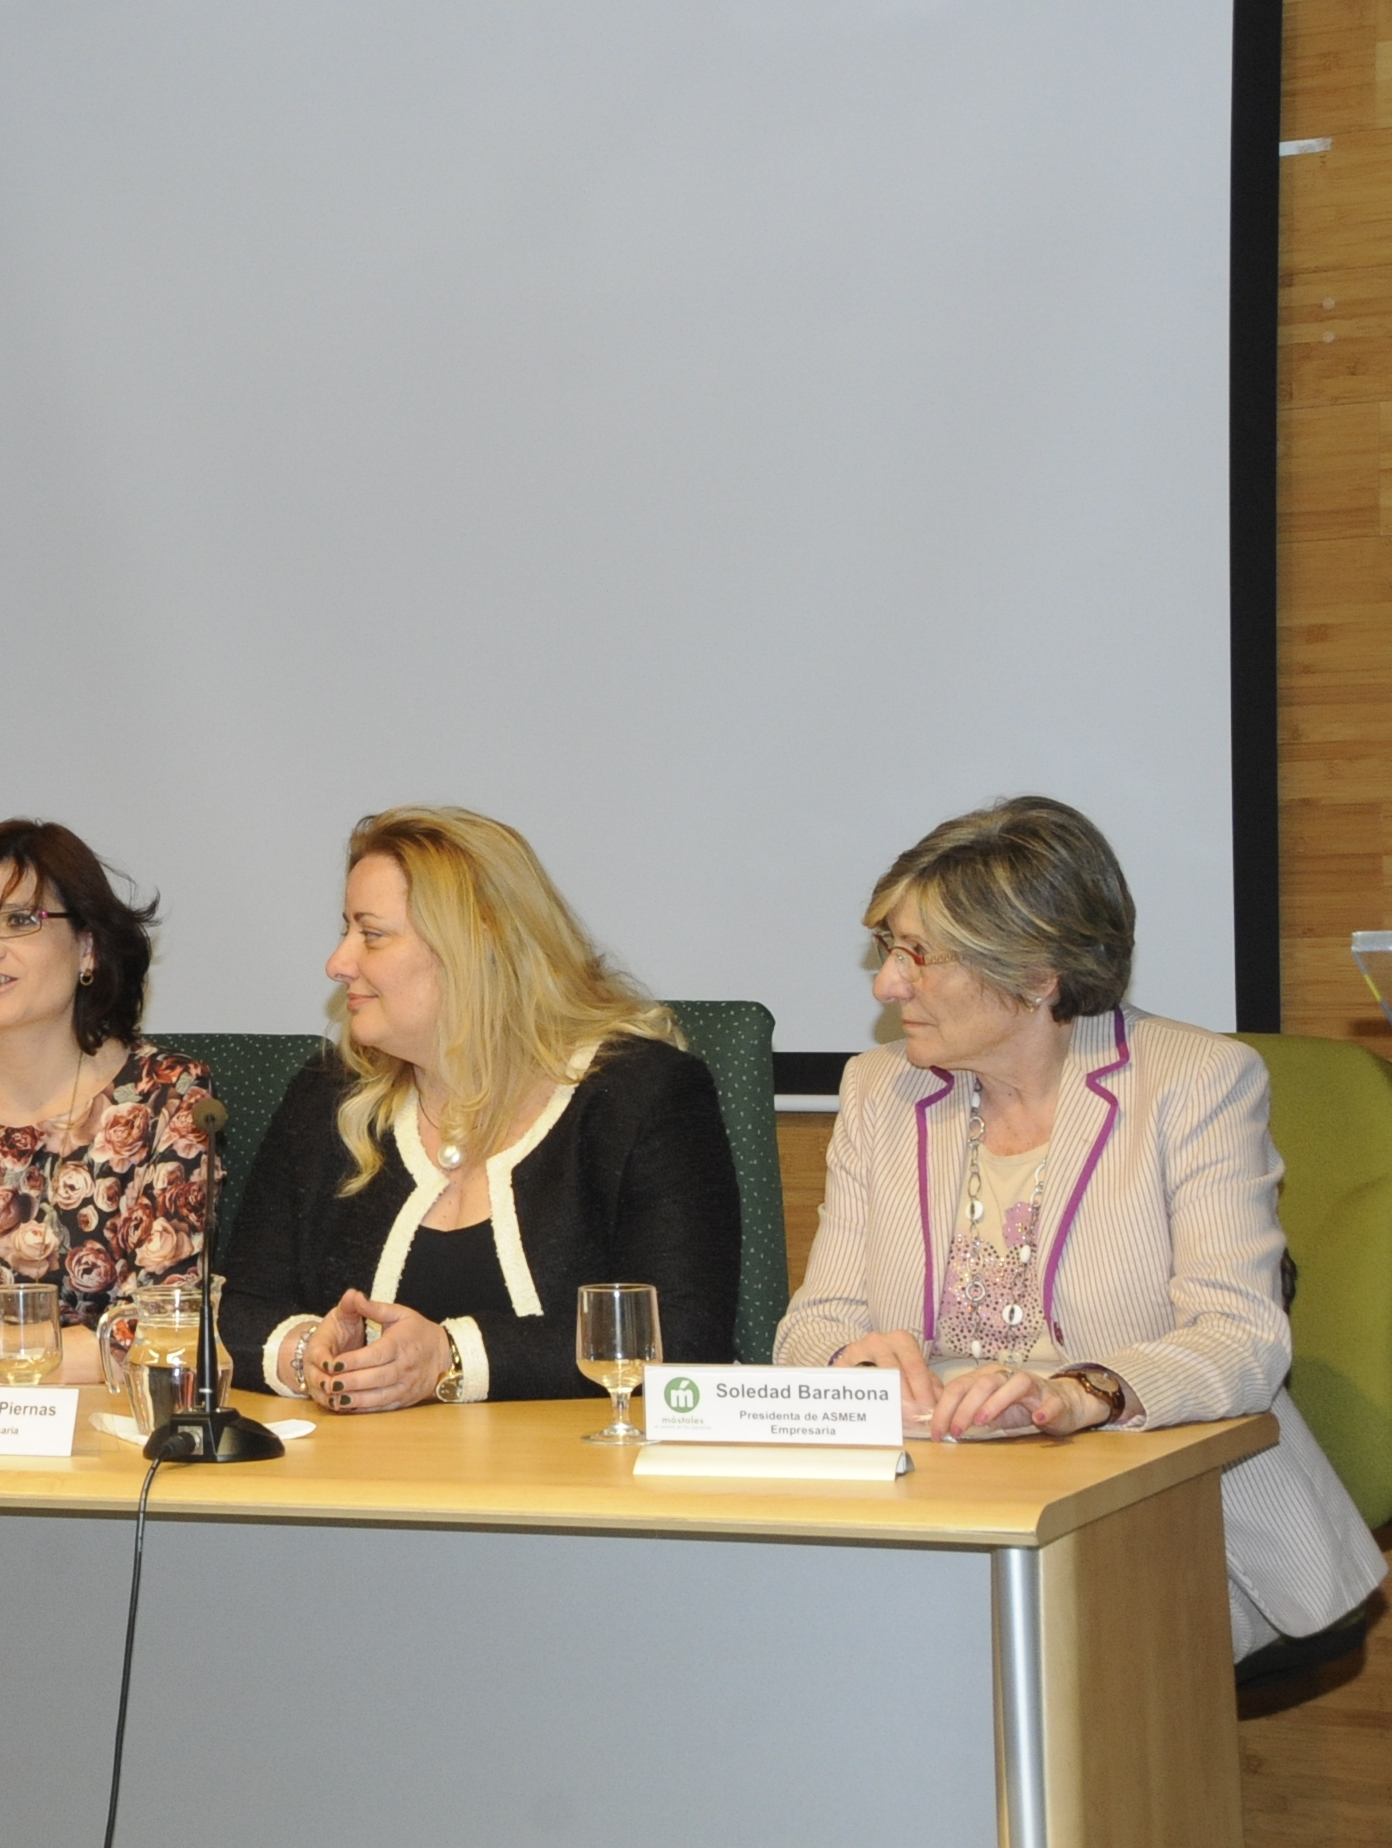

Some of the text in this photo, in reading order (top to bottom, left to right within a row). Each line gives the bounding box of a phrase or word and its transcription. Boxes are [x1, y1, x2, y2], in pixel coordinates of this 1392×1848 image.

[716, 1382, 890, 1401] Soledad Barahona
[0, 1401, 57, 1417] Piernas
[661, 1414, 705, 1425] móstoles
[739, 1410, 867, 1423] Presidenta de ASMEM
[770, 1424, 837, 1437] Empresaria
